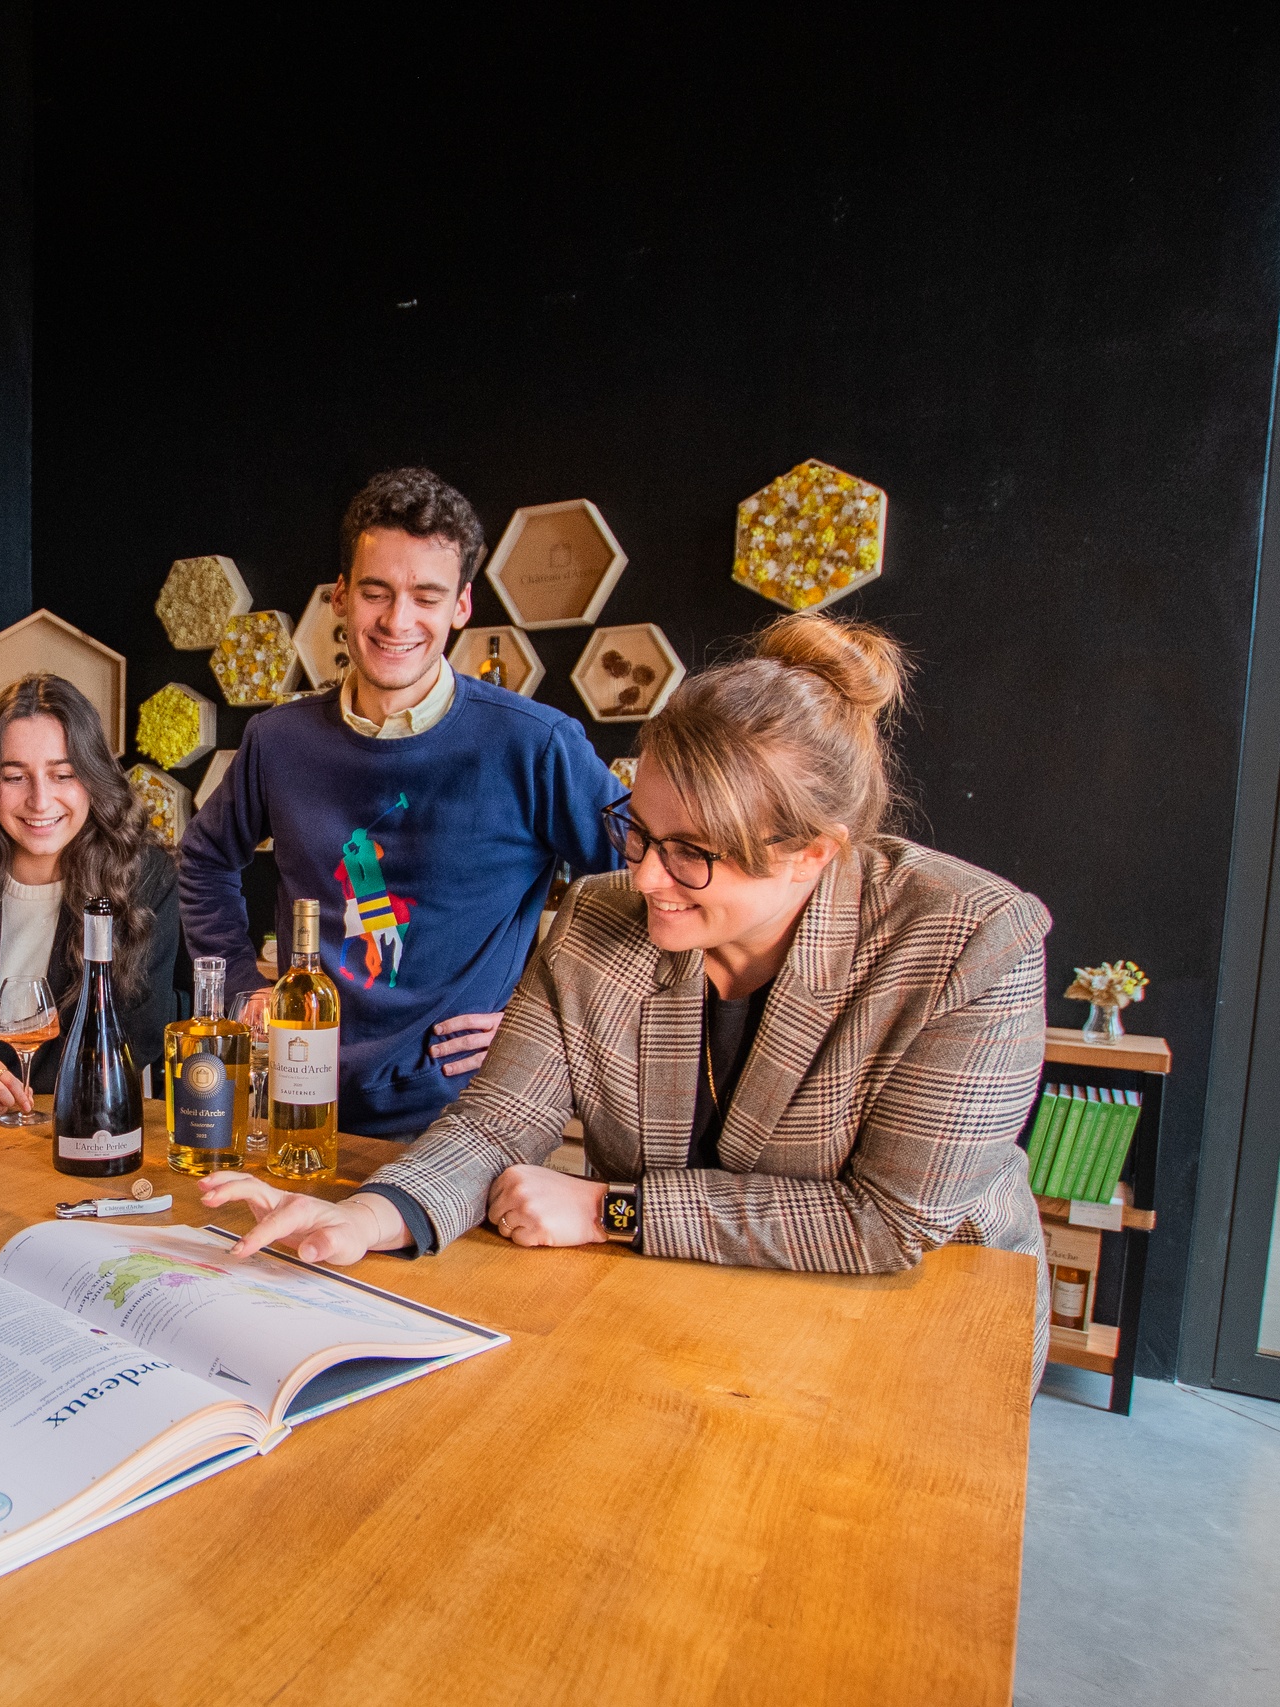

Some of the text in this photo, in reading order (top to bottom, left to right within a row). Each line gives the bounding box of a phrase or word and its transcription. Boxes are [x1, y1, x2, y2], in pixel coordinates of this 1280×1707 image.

[301, 1064, 332, 1074] d'Arche
[180, 1106, 226, 1117] Soleil d'Arche
[75, 1142, 127, 1151] L'Arche Perlée
[42, 1360, 176, 1430] ordeaux
